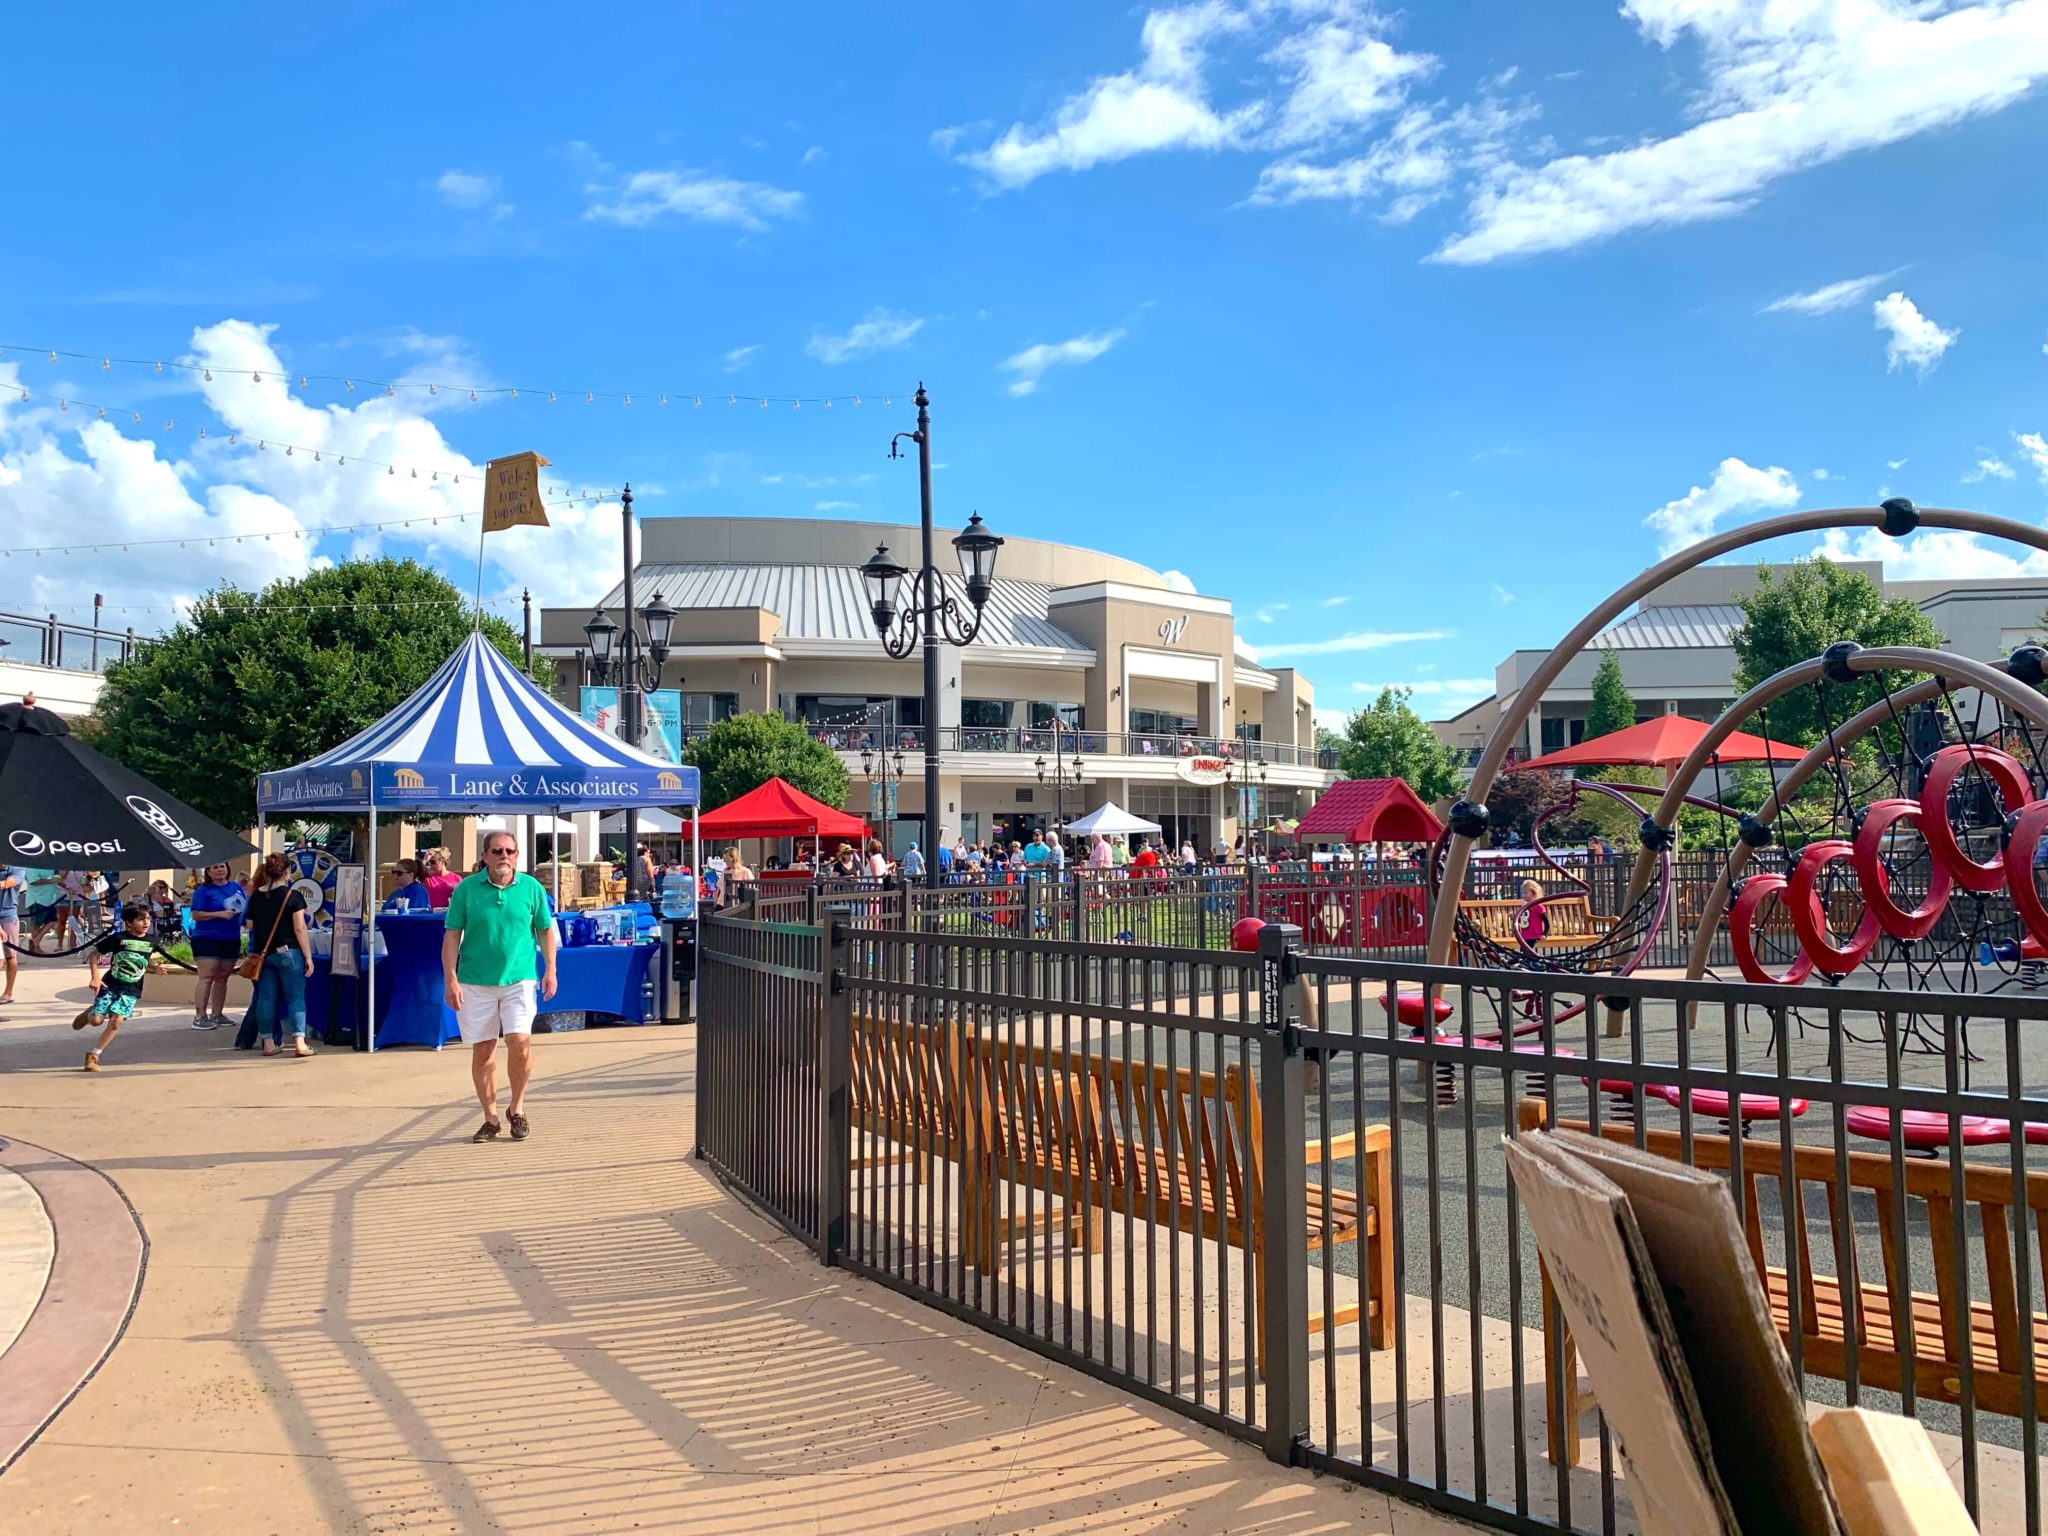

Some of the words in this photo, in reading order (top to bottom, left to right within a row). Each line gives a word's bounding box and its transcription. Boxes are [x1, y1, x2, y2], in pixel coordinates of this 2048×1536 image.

[1160, 614, 1189, 646] W
[664, 719, 678, 727] PM
[278, 781, 295, 801] Lane
[295, 778, 303, 800] &
[303, 776, 344, 799] Associates
[449, 773, 503, 796] Lane
[508, 774, 527, 796] &
[535, 774, 638, 796] Associates
[49, 838, 120, 857] pepsi
[1264, 960, 1272, 1024] FENCES
[1271, 963, 1279, 1023] UNLIMITED
